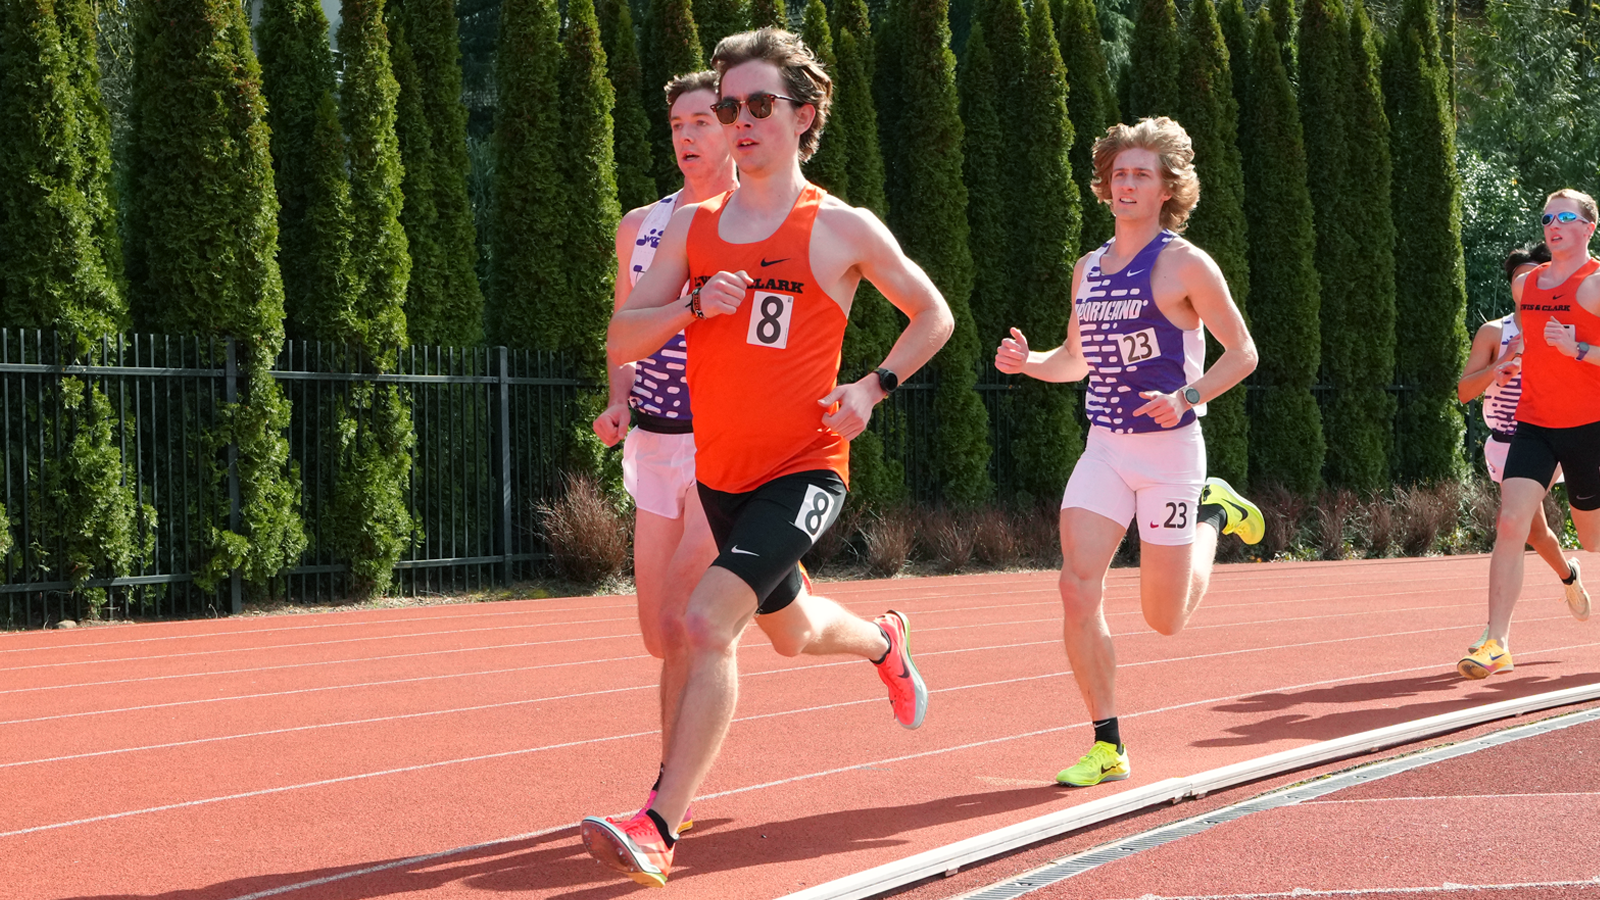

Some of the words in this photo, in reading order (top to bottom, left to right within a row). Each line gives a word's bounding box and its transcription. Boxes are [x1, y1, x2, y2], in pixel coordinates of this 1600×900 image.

[756, 295, 784, 344] 8
[1078, 300, 1143, 322] PORTLAND
[1123, 332, 1153, 363] 23
[805, 492, 829, 536] 8
[1163, 502, 1188, 529] 23
